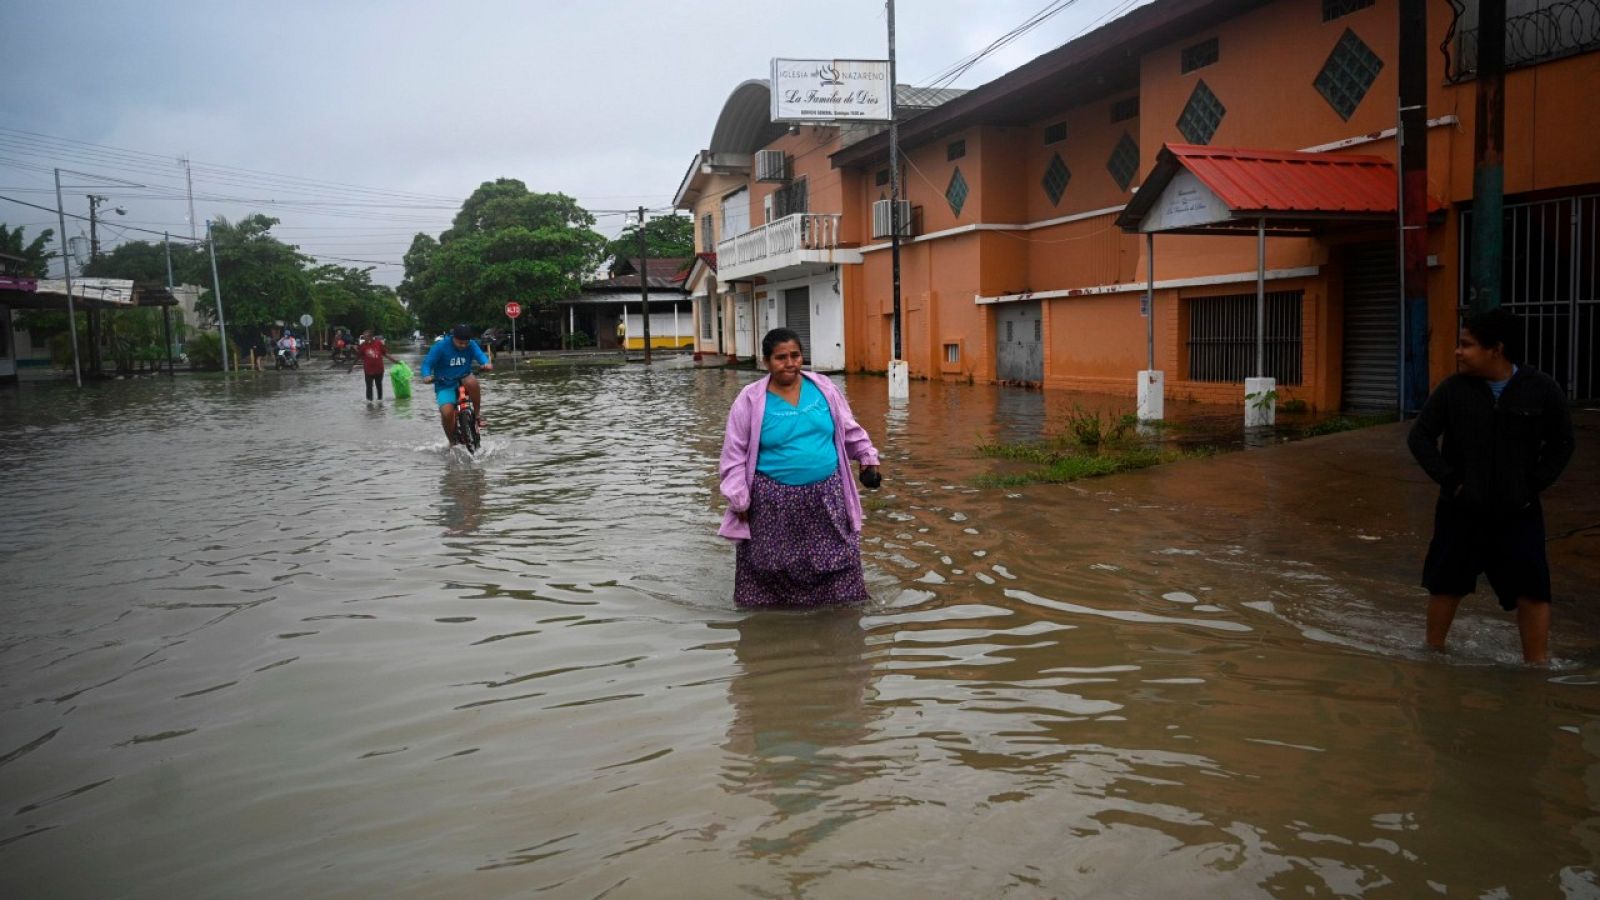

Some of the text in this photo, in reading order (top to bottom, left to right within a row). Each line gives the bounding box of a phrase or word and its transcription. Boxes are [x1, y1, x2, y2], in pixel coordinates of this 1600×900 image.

[779, 70, 808, 78] IGLESIA
[842, 71, 884, 80] NAZARENO
[785, 89, 879, 104] La Familia de Dios
